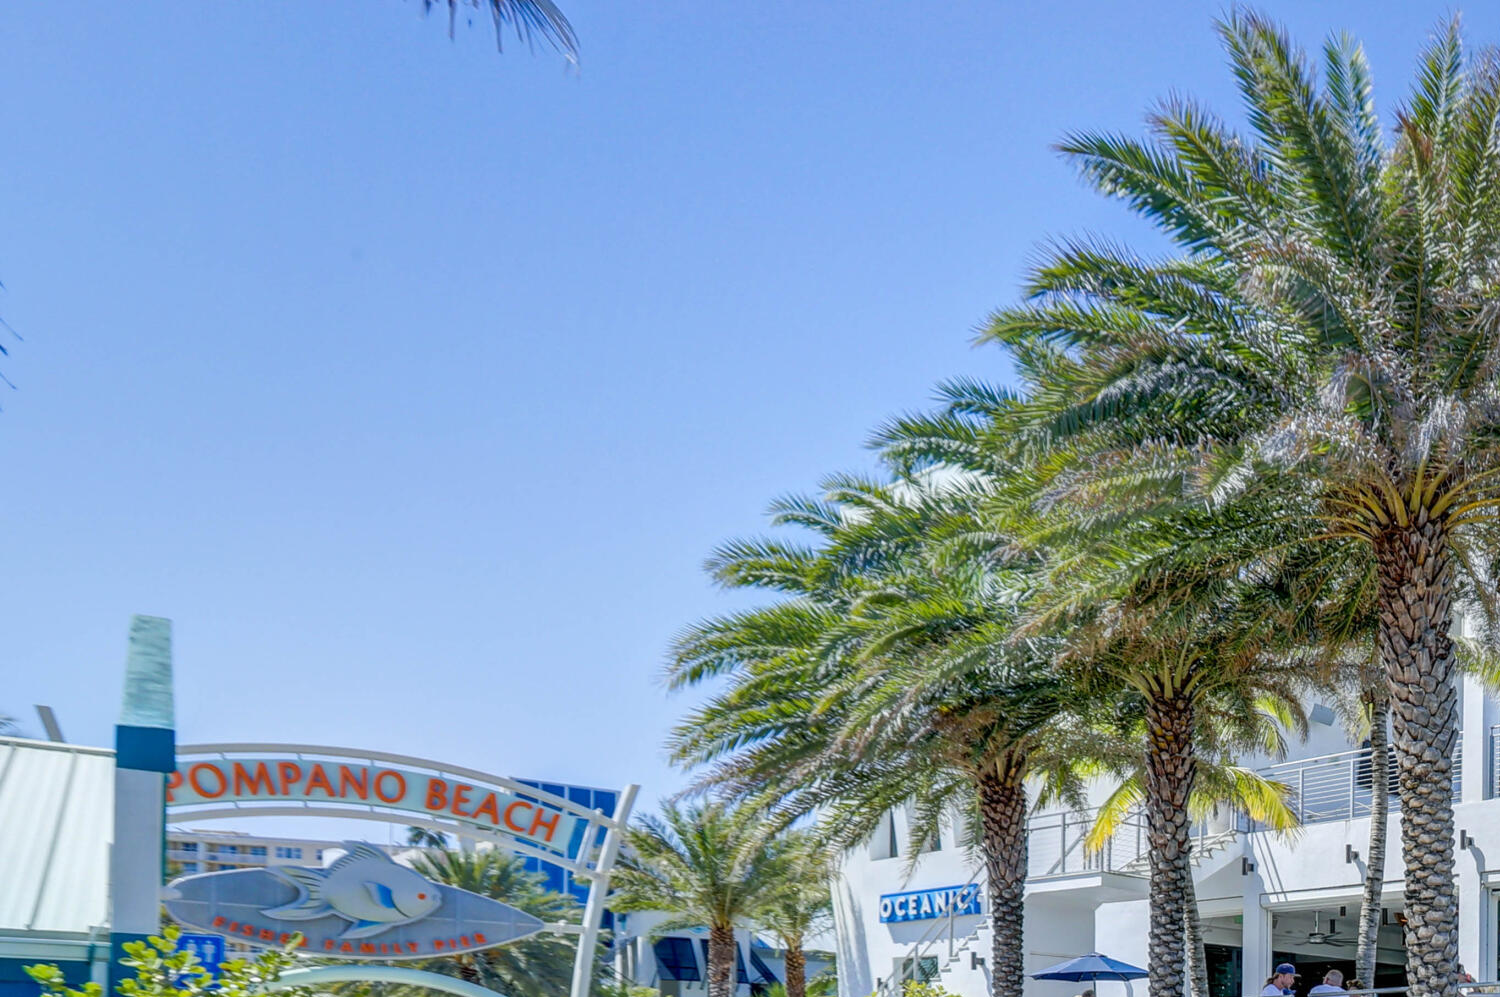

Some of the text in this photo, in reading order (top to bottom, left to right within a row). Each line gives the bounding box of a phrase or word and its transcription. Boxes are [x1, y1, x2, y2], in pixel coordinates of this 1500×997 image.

[166, 761, 560, 842] POMPANO BEACH
[880, 889, 969, 918] OCEANIC
[324, 939, 418, 955] FAMILY
[433, 932, 487, 951] PIER
